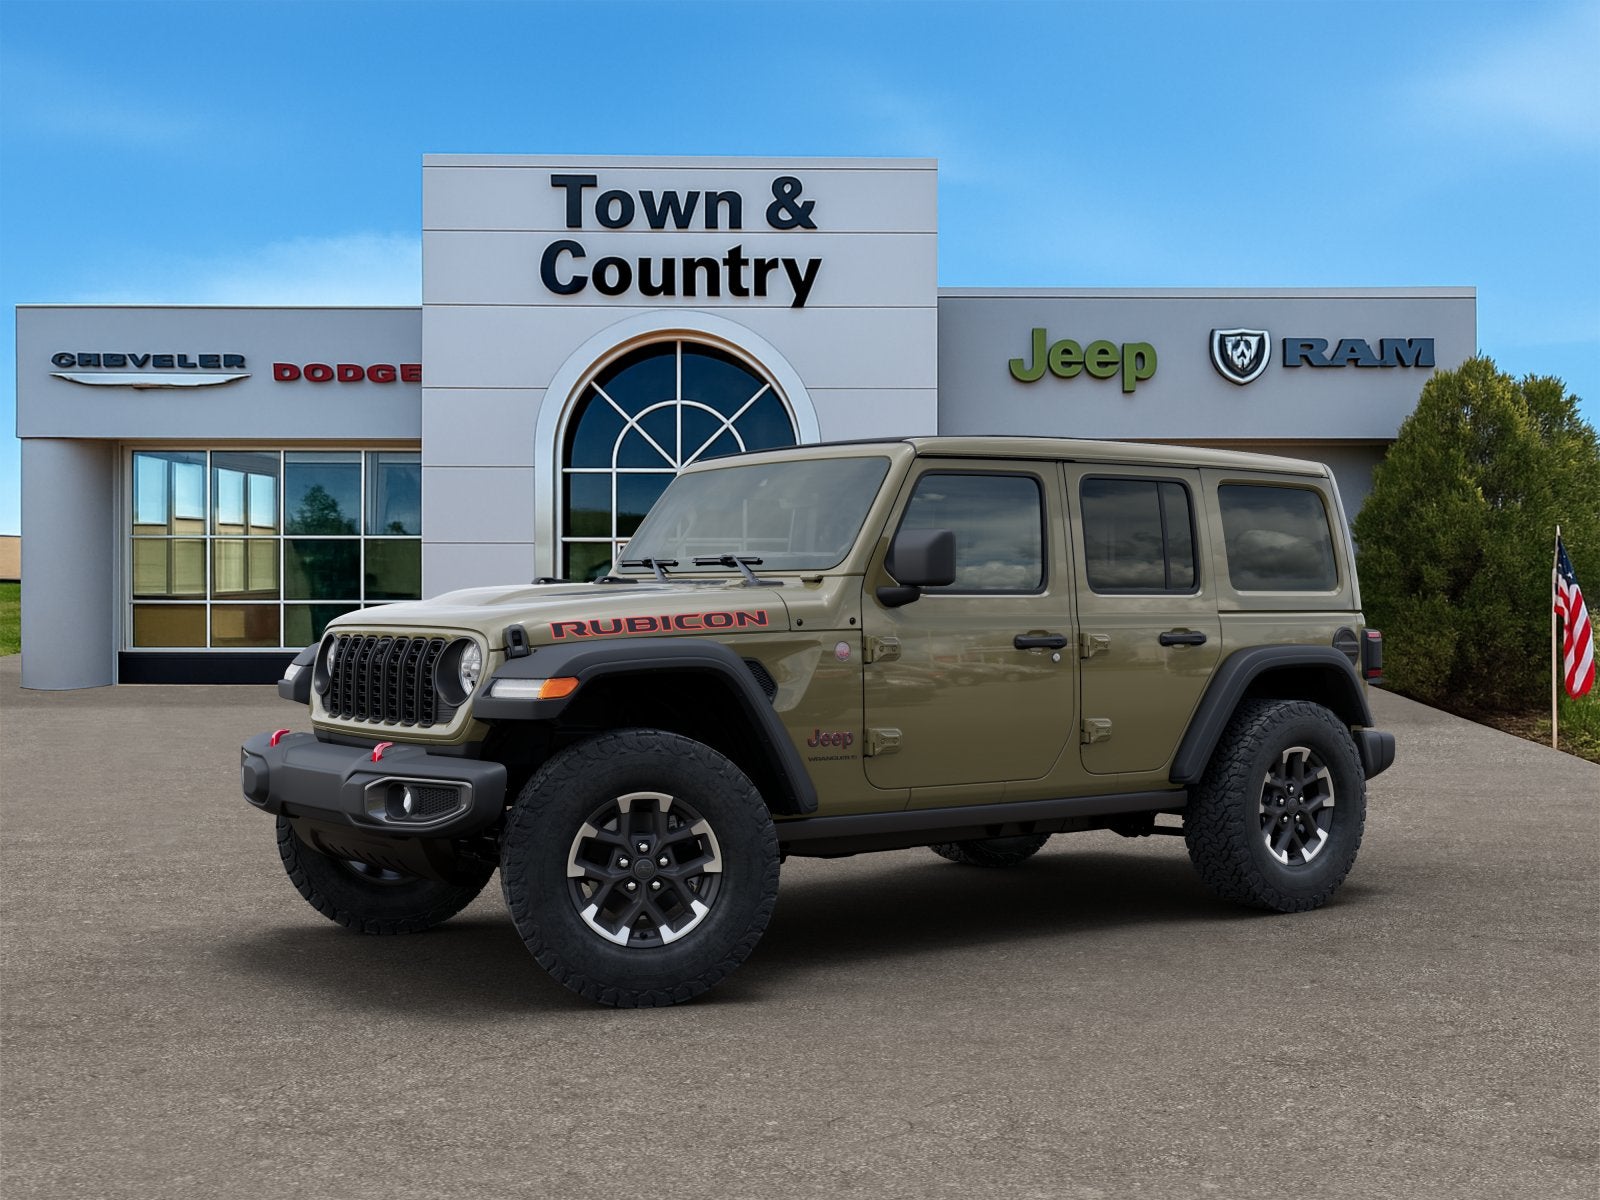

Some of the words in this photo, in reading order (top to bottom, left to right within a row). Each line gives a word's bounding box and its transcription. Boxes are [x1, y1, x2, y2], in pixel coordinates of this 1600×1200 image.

[550, 174, 743, 230] Town
[765, 175, 818, 230] &
[540, 239, 822, 308] Country
[1008, 328, 1158, 393] Jeep
[1283, 337, 1436, 368] RAM
[272, 363, 422, 383] DODGE
[550, 609, 769, 640] RUBICON
[807, 728, 853, 750] Jeep
